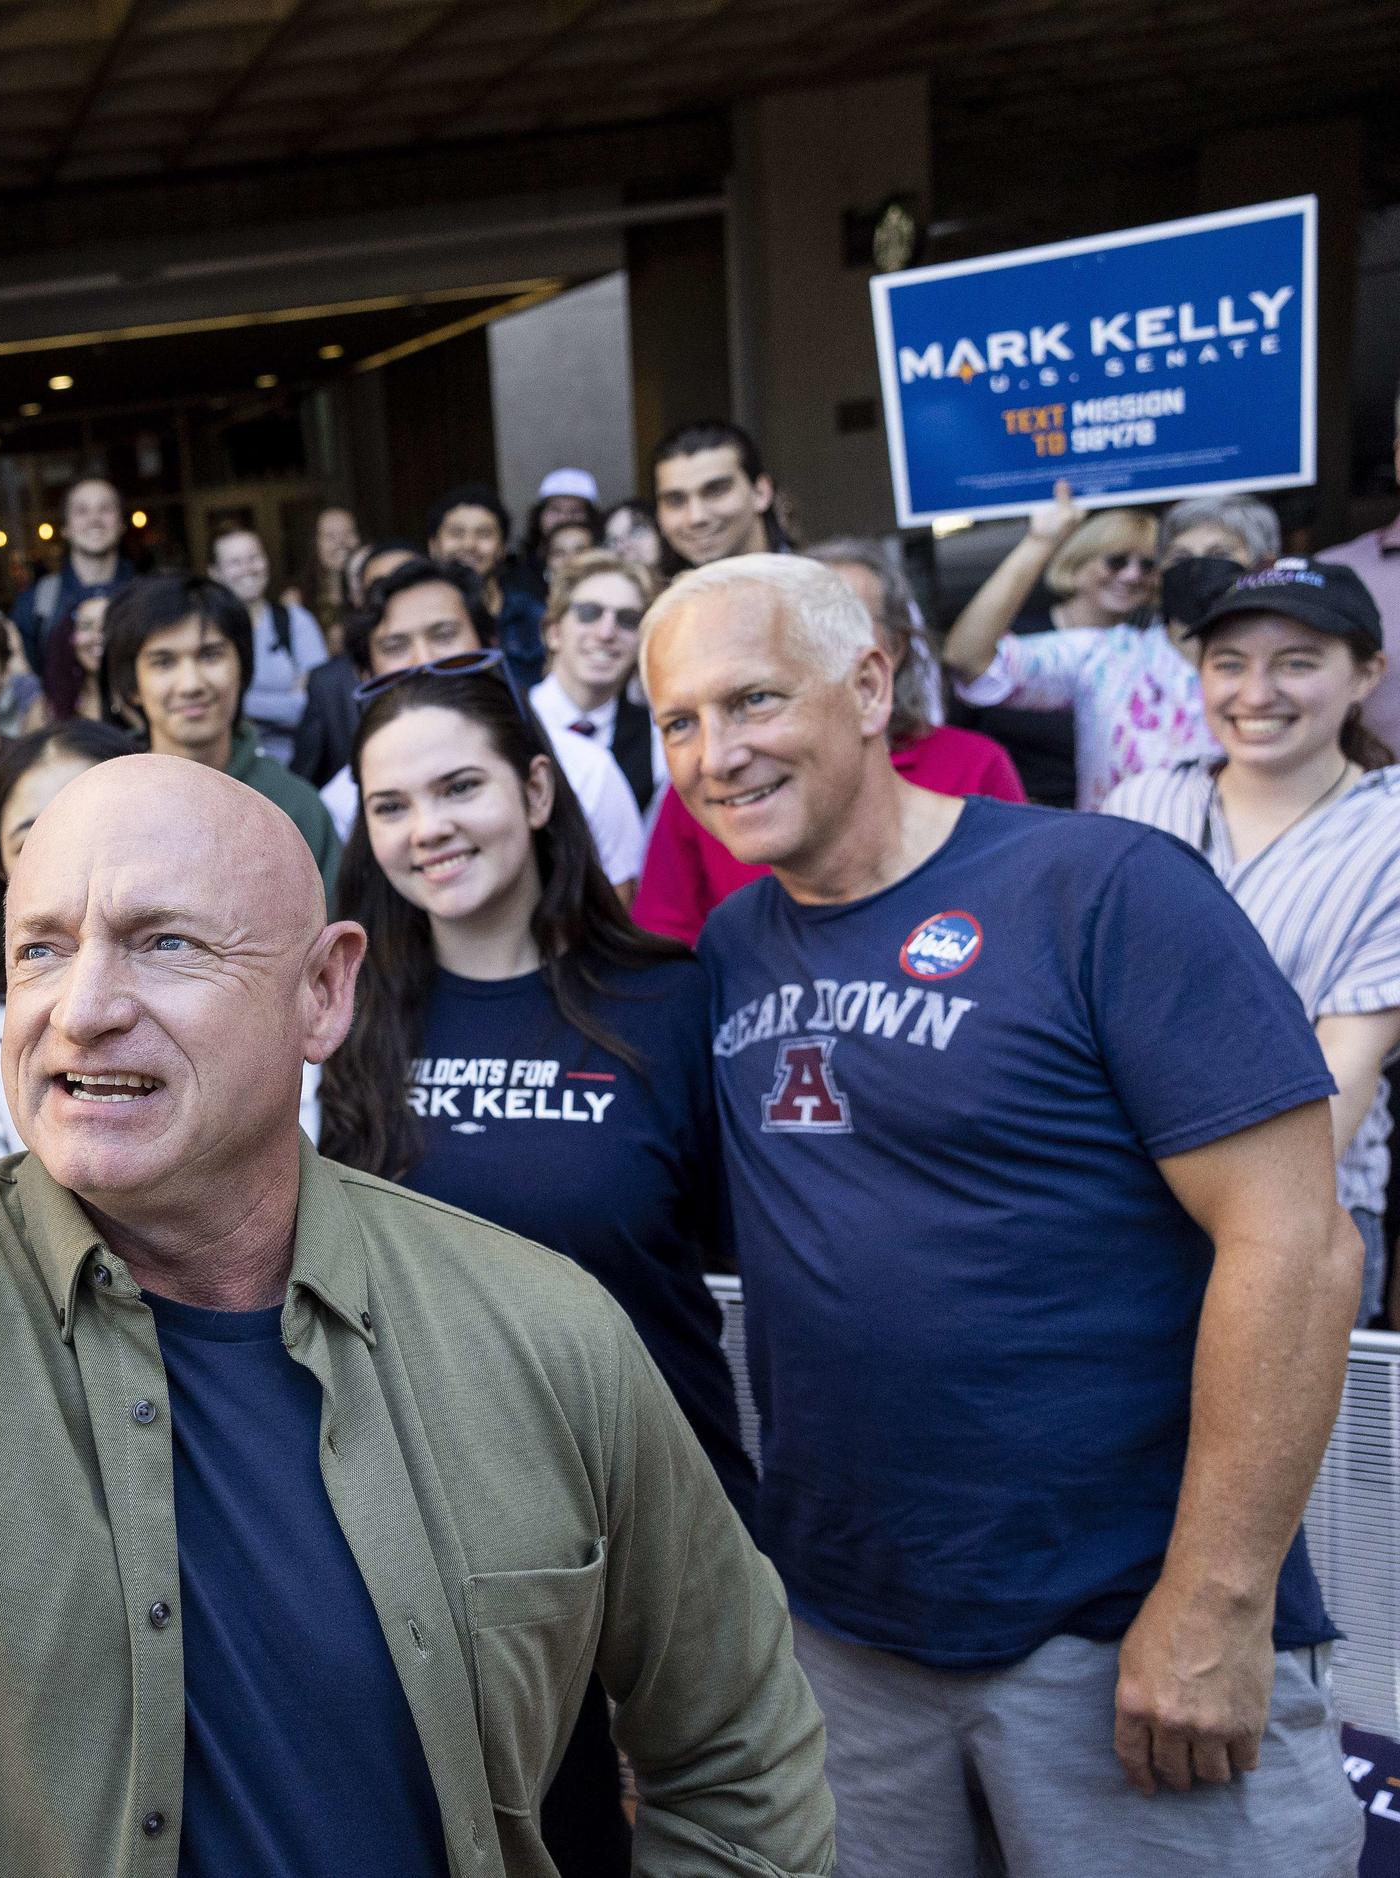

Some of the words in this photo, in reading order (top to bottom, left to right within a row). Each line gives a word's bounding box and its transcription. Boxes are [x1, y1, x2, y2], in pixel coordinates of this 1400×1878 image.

[899, 321, 1075, 385] MARK
[1090, 285, 1295, 356] KELLY
[989, 366, 1080, 394] U.S.
[1104, 333, 1282, 378] SENATE
[1003, 403, 1067, 435] TEXT
[1071, 387, 1186, 428] MISSION
[1032, 430, 1068, 458] TO
[805, 978, 974, 1051] DOWN
[509, 1060, 560, 1088] FOR
[760, 1034, 855, 1134] A
[406, 1086, 461, 1118] RK
[472, 1087, 616, 1124] KELLY
